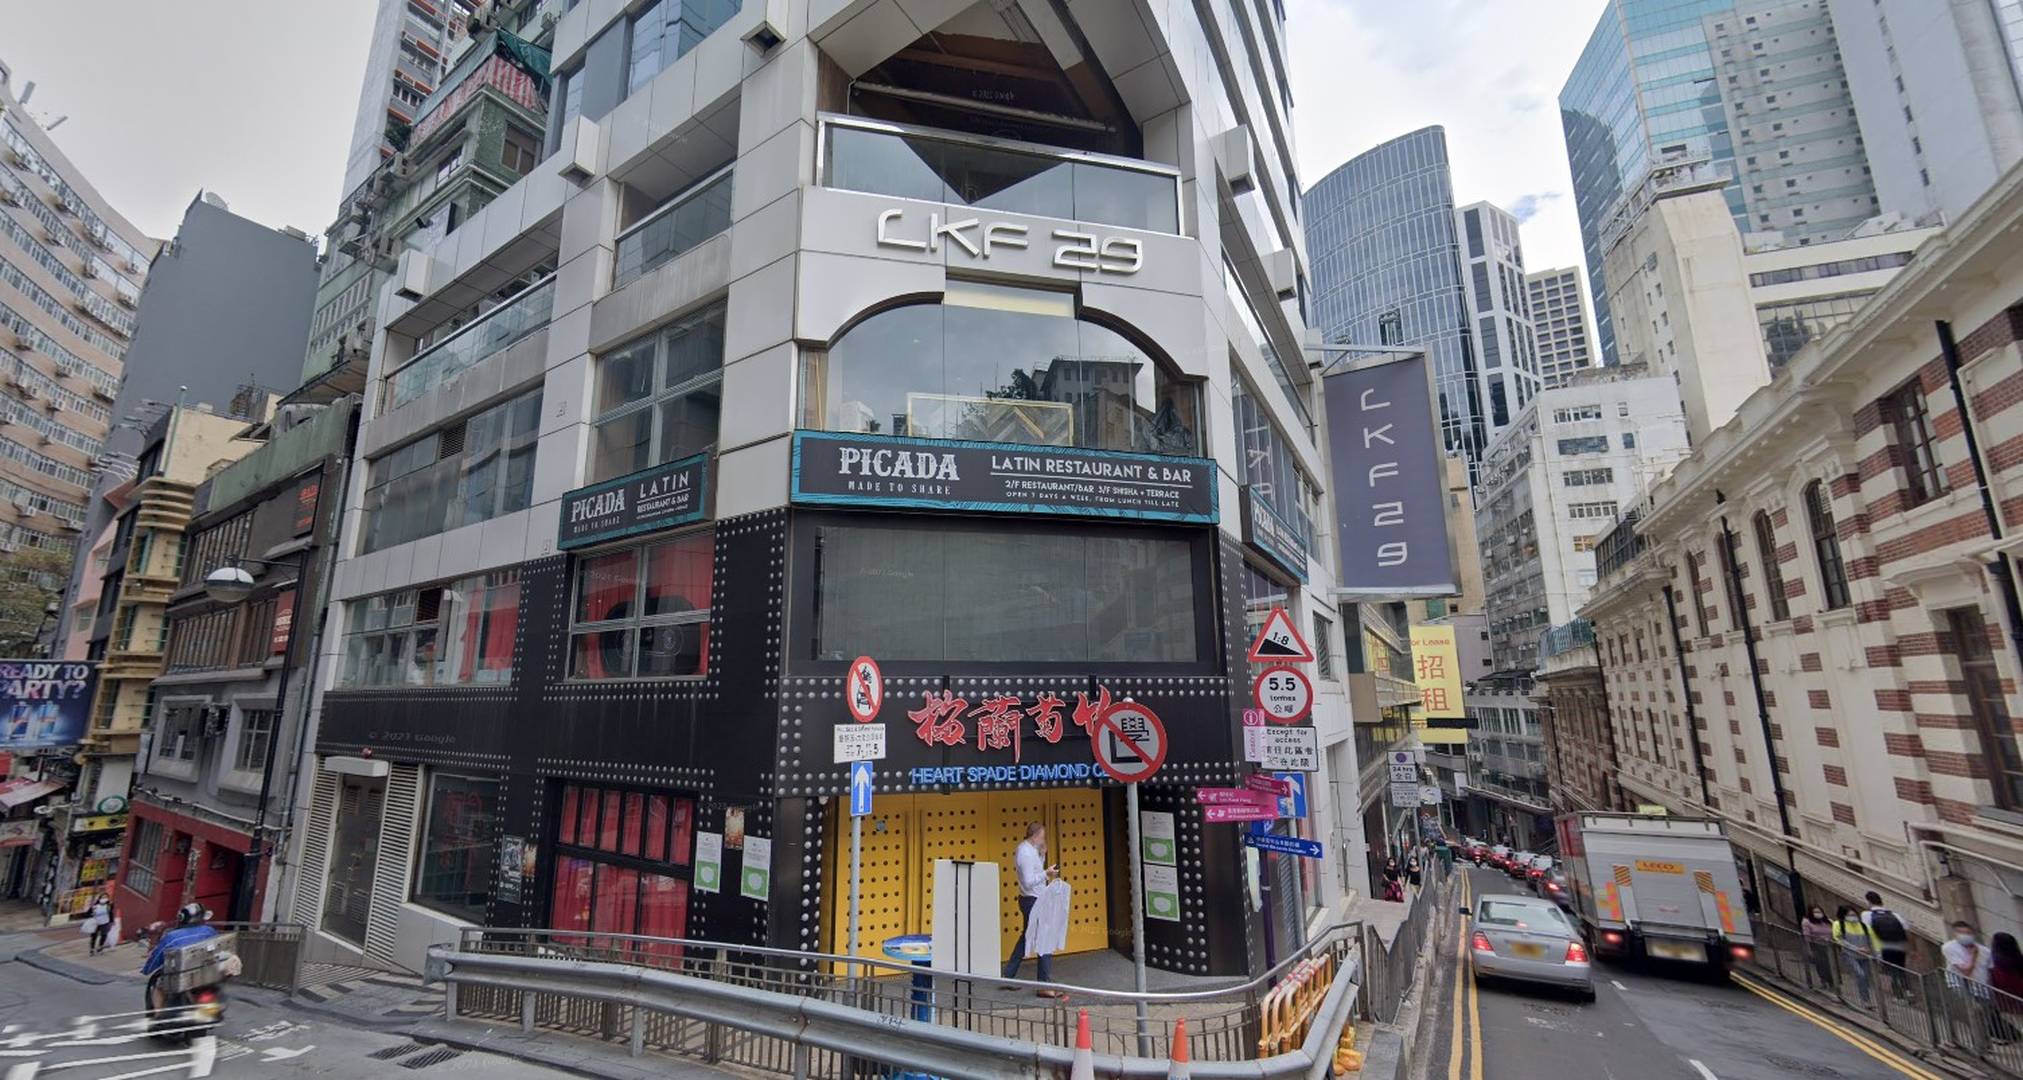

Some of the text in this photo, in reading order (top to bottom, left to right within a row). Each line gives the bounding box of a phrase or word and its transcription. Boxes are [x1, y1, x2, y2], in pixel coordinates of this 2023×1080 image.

[1052, 229, 1143, 274] 29
[838, 447, 960, 481] PICADA
[991, 455, 1192, 482] LATIN RESTAURANT & BAR
[640, 471, 689, 499] LATIN
[848, 481, 951, 495] MADE TO SHARE
[1021, 481, 1094, 493] RESTAURANT/BAR
[1146, 489, 1180, 499] TERRACE
[571, 489, 625, 522] PICADA
[1161, 500, 1179, 508] LATE
[1273, 631, 1290, 646] 1:8
[0, 664, 89, 680] READY TO
[1269, 677, 1296, 691] 5.5
[1416, 654, 1451, 713] 招租
[1266, 729, 1293, 737] Except
[911, 767, 965, 785] HEART
[967, 765, 1018, 782] SPADE
[1021, 763, 1089, 781] DIAMOND
